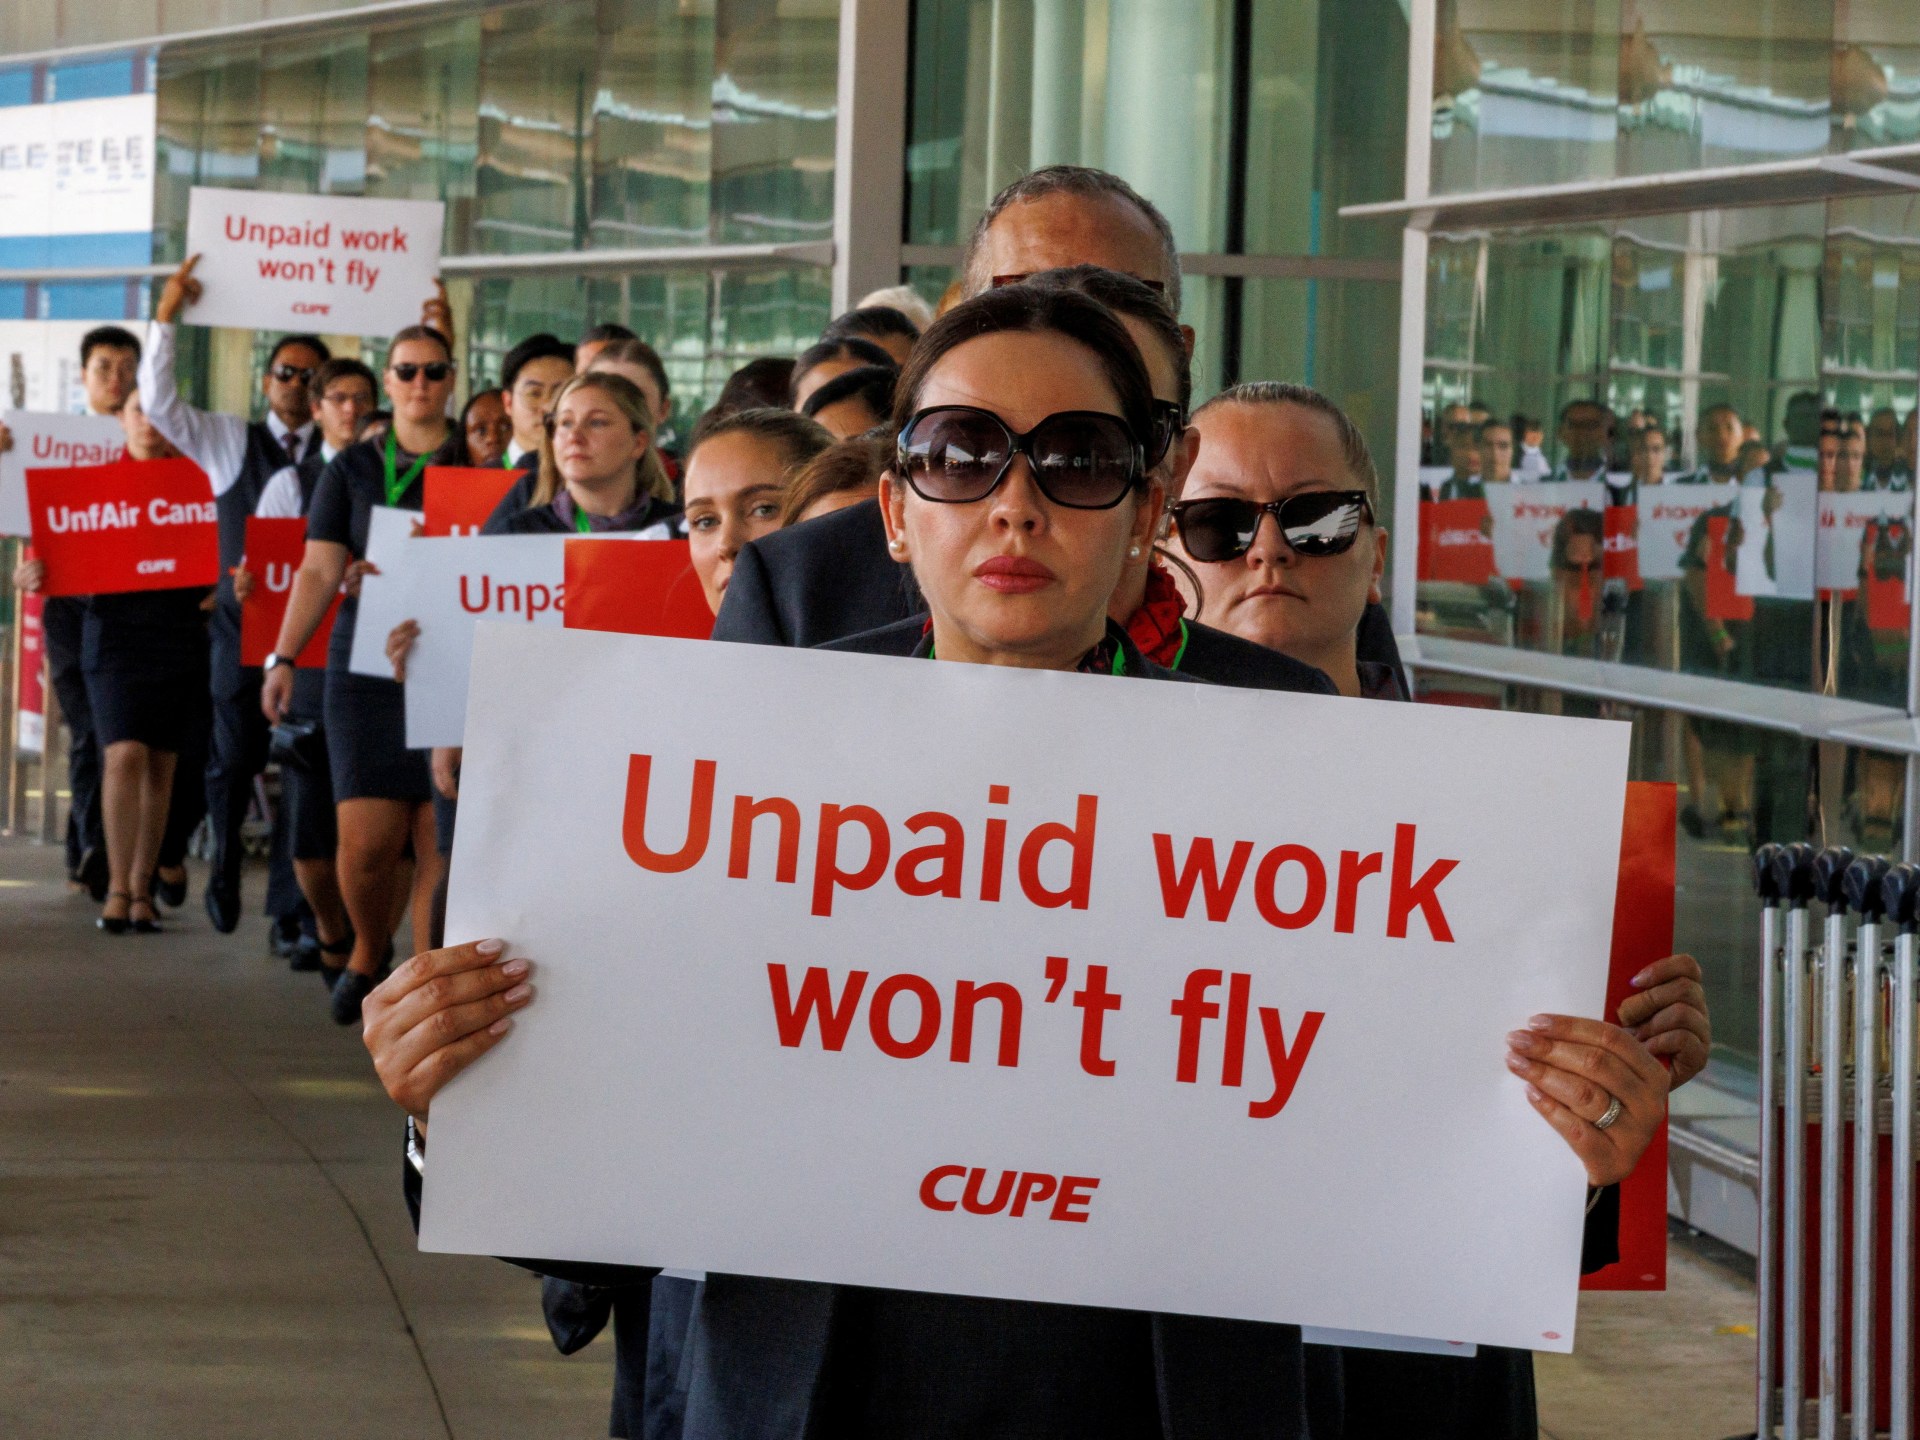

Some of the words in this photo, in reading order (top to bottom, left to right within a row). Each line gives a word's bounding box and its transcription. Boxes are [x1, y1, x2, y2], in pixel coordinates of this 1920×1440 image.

[224, 215, 331, 251] Unpaid
[341, 227, 408, 252] work
[258, 259, 336, 284] won’t
[345, 260, 381, 292] fly
[292, 302, 331, 316] CUPE
[47, 501, 140, 533] UnfAir
[148, 498, 218, 526] Cana
[136, 559, 176, 574] CUPE
[622, 753, 1099, 918] Unpaid
[1152, 823, 1460, 943] work
[767, 956, 1122, 1077] won’t
[1170, 969, 1325, 1120] fly
[919, 1164, 1101, 1223] CUPE
